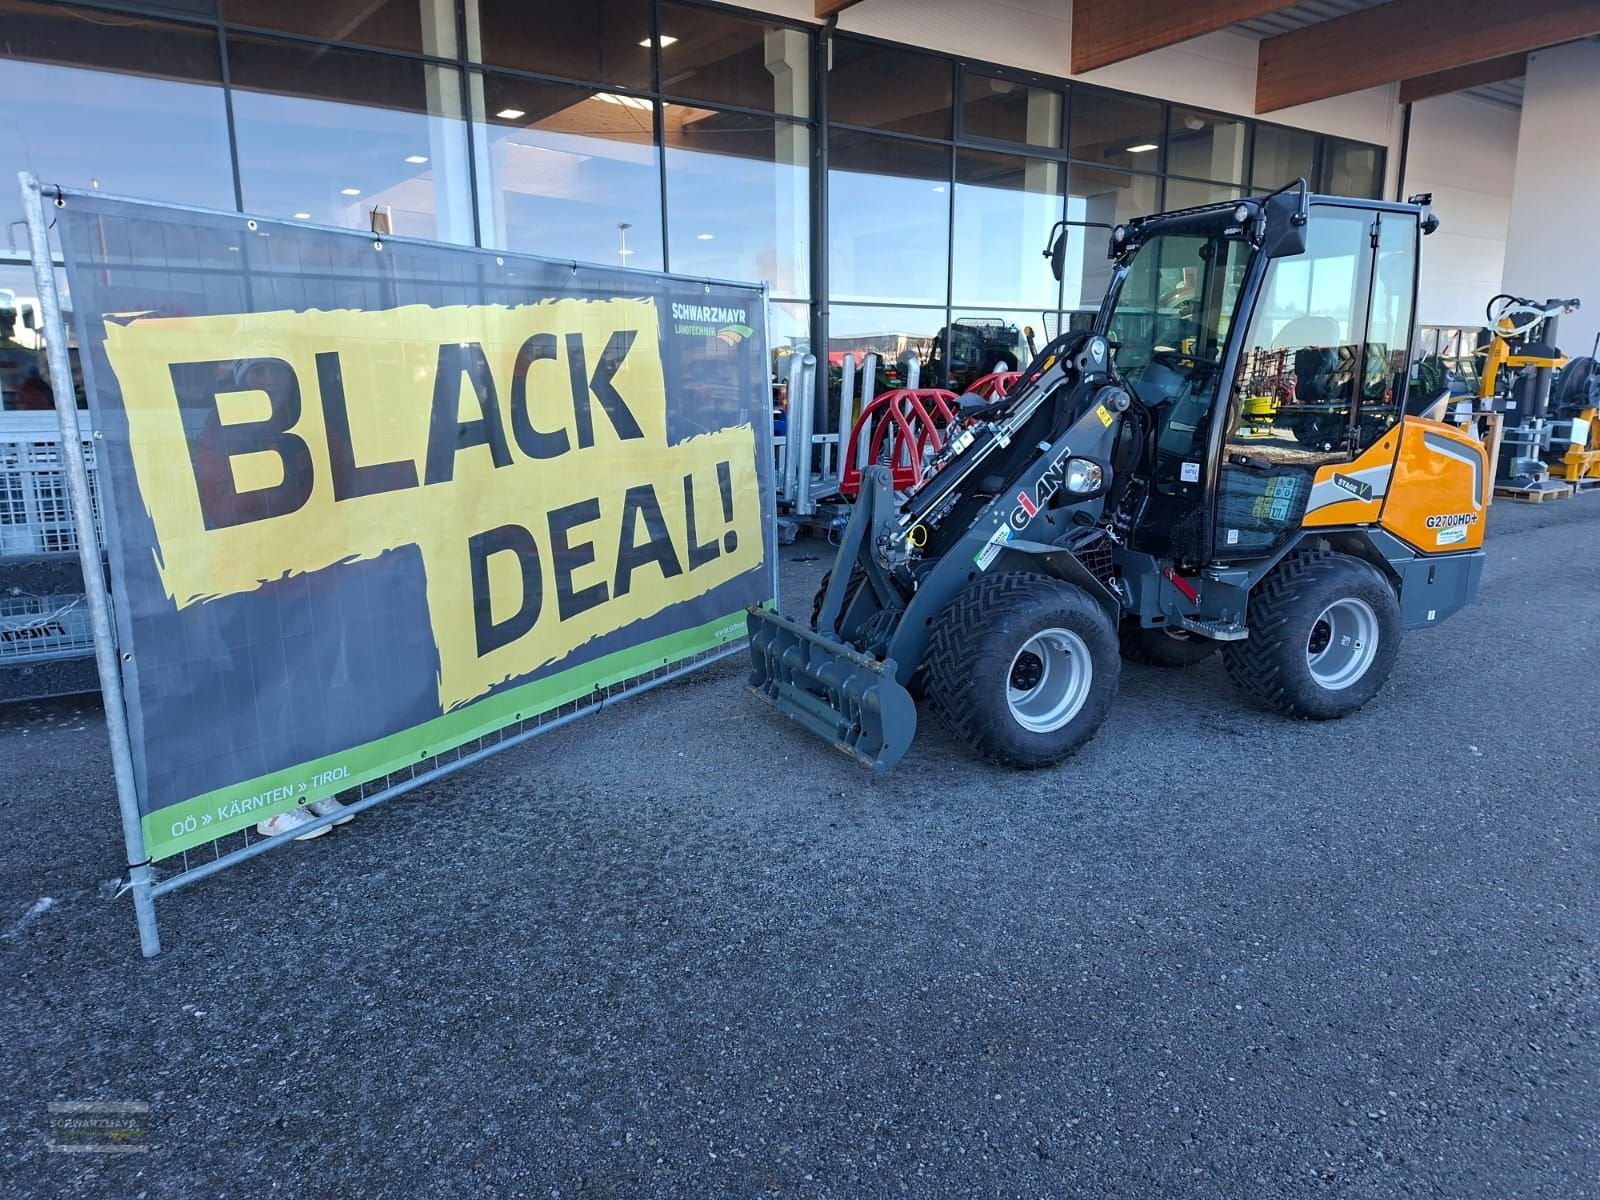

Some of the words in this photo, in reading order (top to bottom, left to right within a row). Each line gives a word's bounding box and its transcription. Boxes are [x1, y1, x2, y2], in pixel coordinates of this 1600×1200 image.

[671, 302, 746, 324] SCHWARZMAYR
[674, 324, 716, 336] LANDTECHNIK
[168, 329, 645, 531] BLACK
[1337, 478, 1359, 493] STAGE
[1359, 483, 1370, 496] V
[1425, 512, 1478, 529] G2700HD+
[468, 460, 739, 659] DEAL!
[171, 814, 198, 838] OÖ
[217, 783, 294, 821] KÄRNTEN
[311, 765, 351, 789] TIROL
